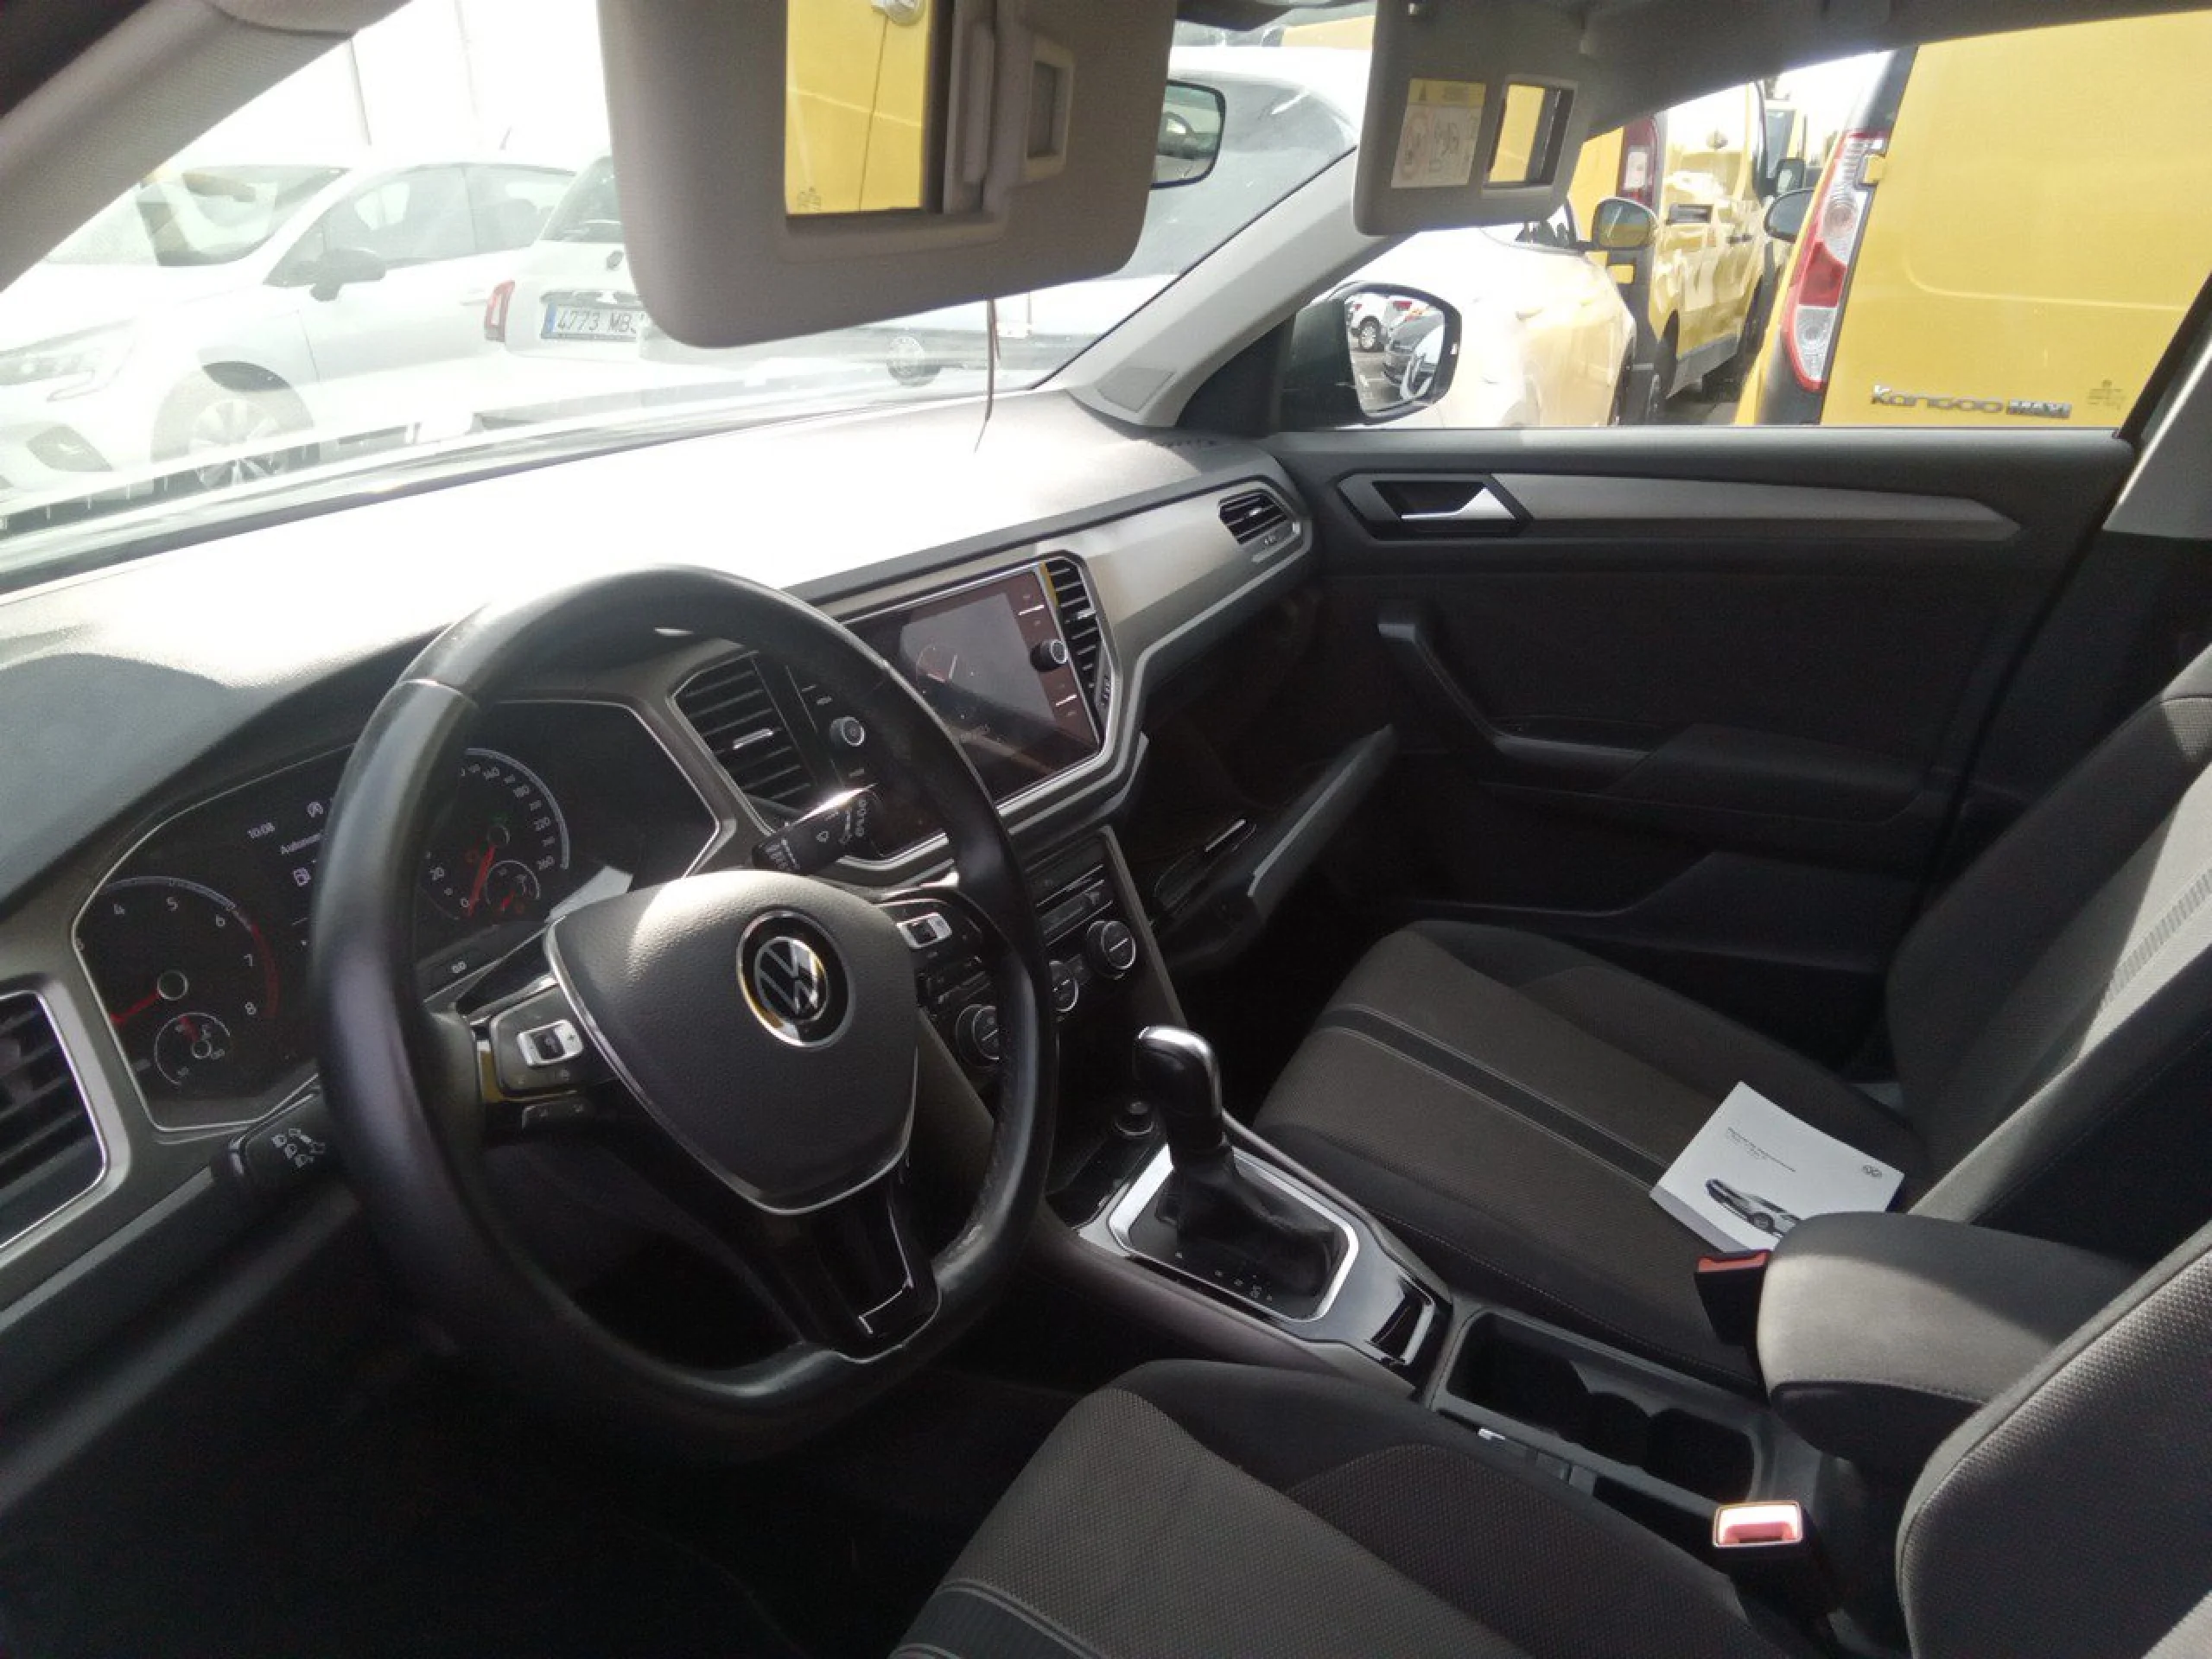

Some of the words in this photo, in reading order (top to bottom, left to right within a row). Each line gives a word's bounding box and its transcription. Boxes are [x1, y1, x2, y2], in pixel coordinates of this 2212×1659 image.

[556, 309, 601, 331] 4773
[1872, 385, 2004, 413] Kangoo
[113, 903, 125, 915] 4
[166, 896, 178, 912] 5
[215, 913, 226, 927] 6
[243, 953, 253, 967] 7
[245, 1001, 257, 1015] 8
